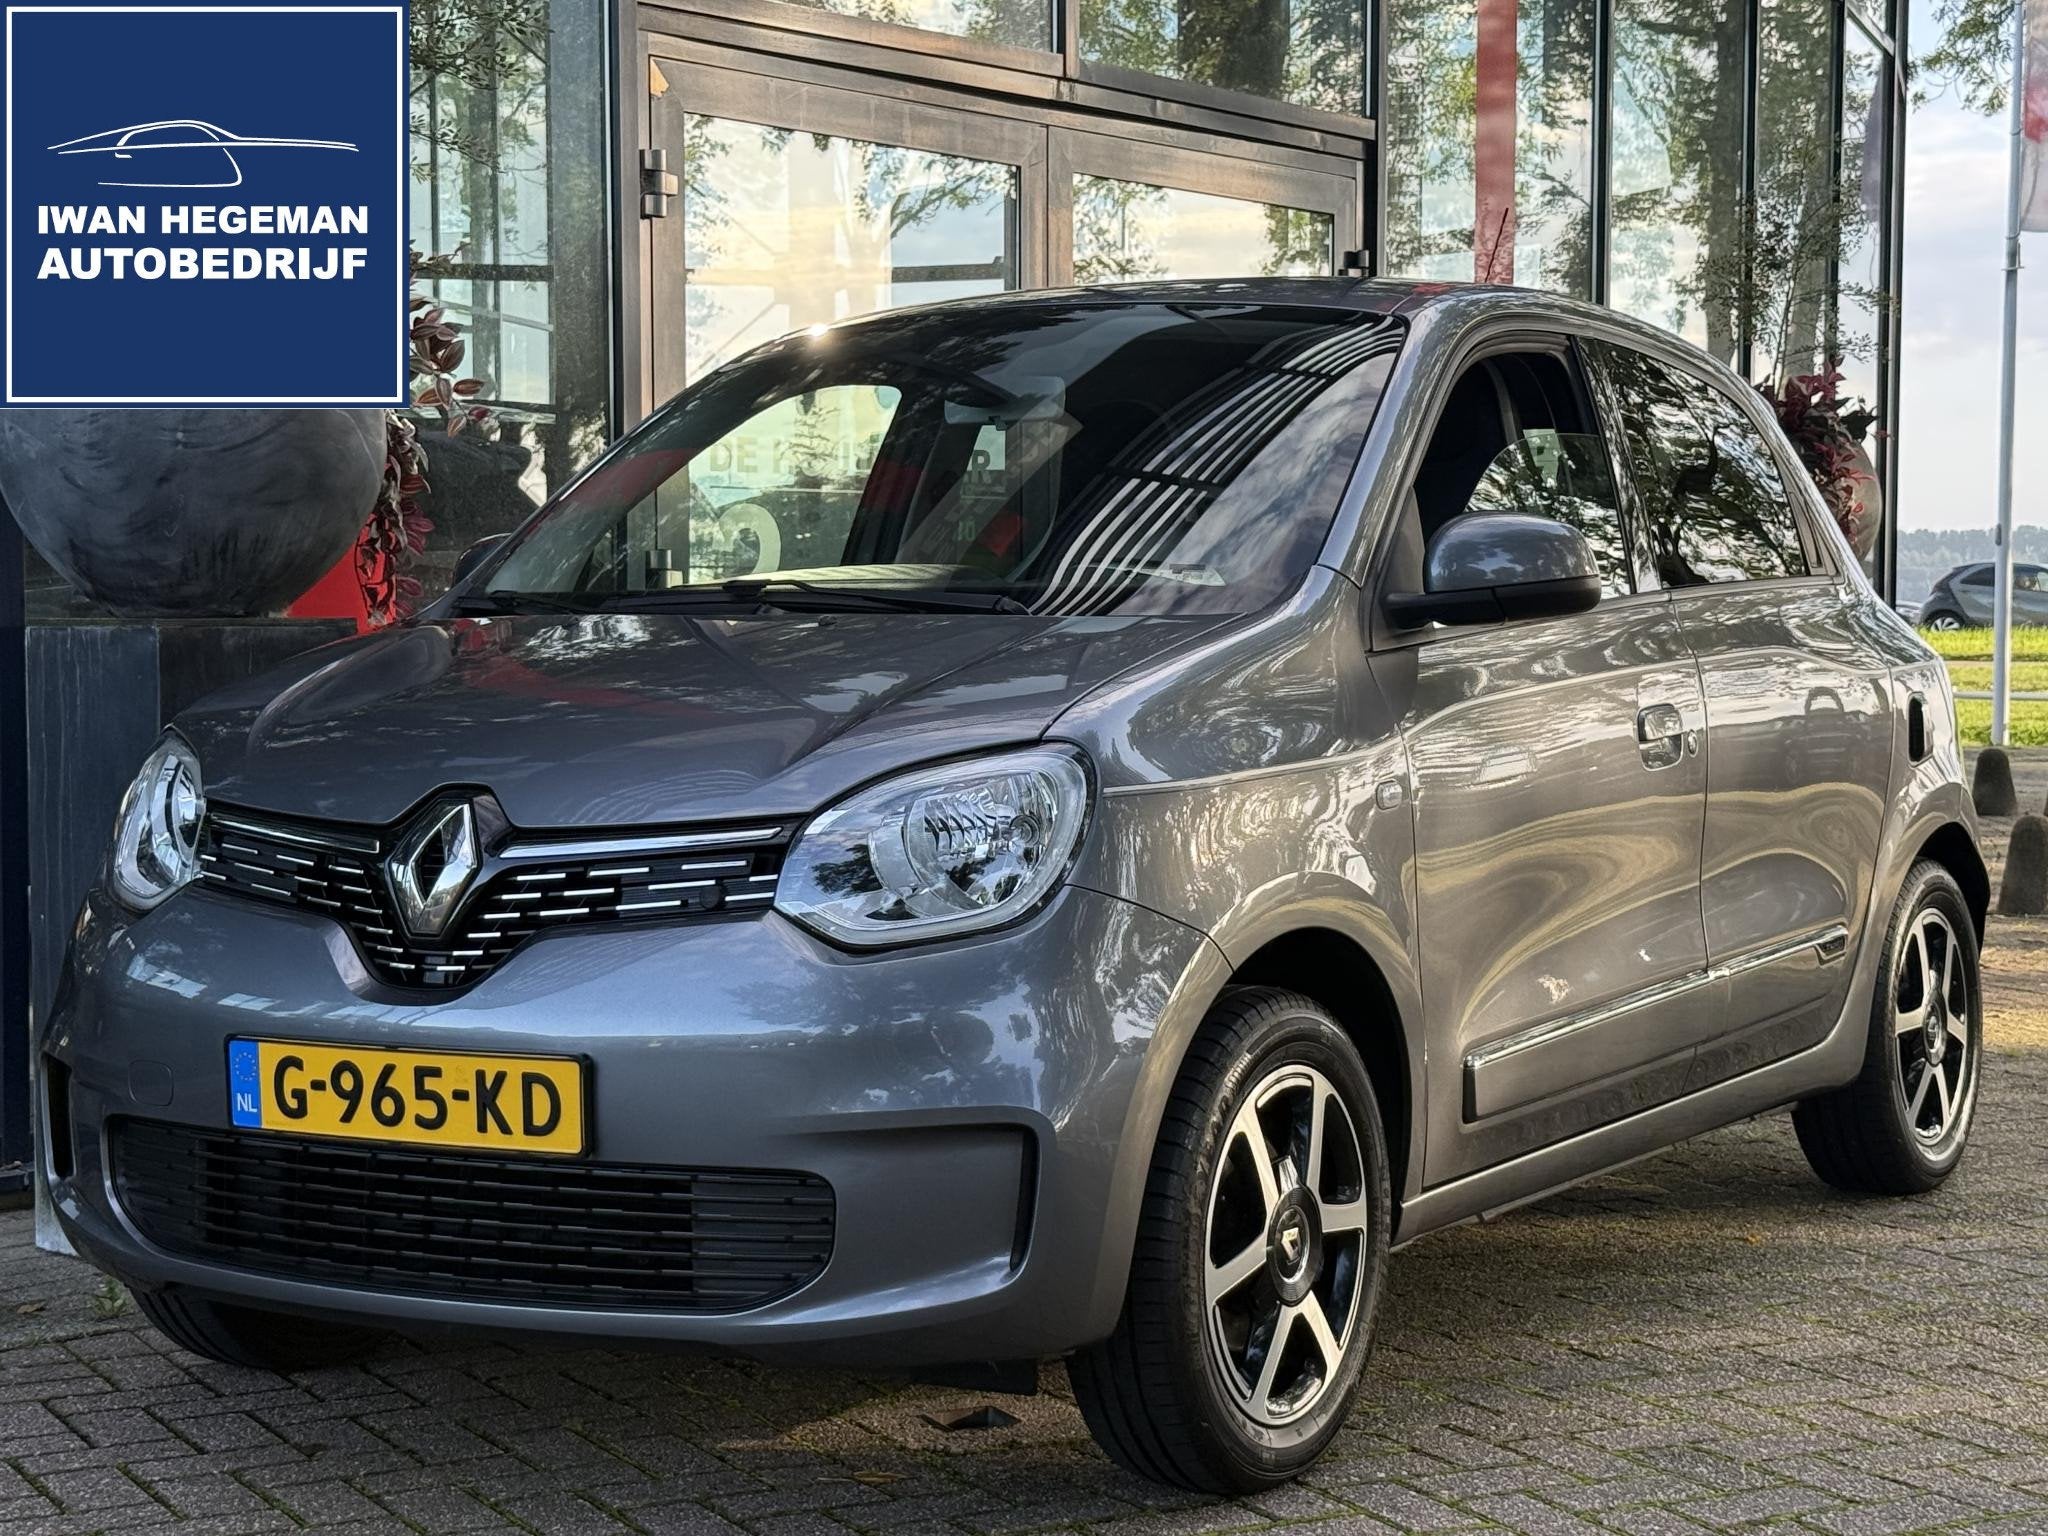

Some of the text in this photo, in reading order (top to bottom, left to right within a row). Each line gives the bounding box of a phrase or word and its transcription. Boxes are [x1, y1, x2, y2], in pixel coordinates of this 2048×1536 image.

[710, 437, 758, 473] DE
[237, 1093, 258, 1113] NL
[273, 1055, 562, 1137] G-965-KD
